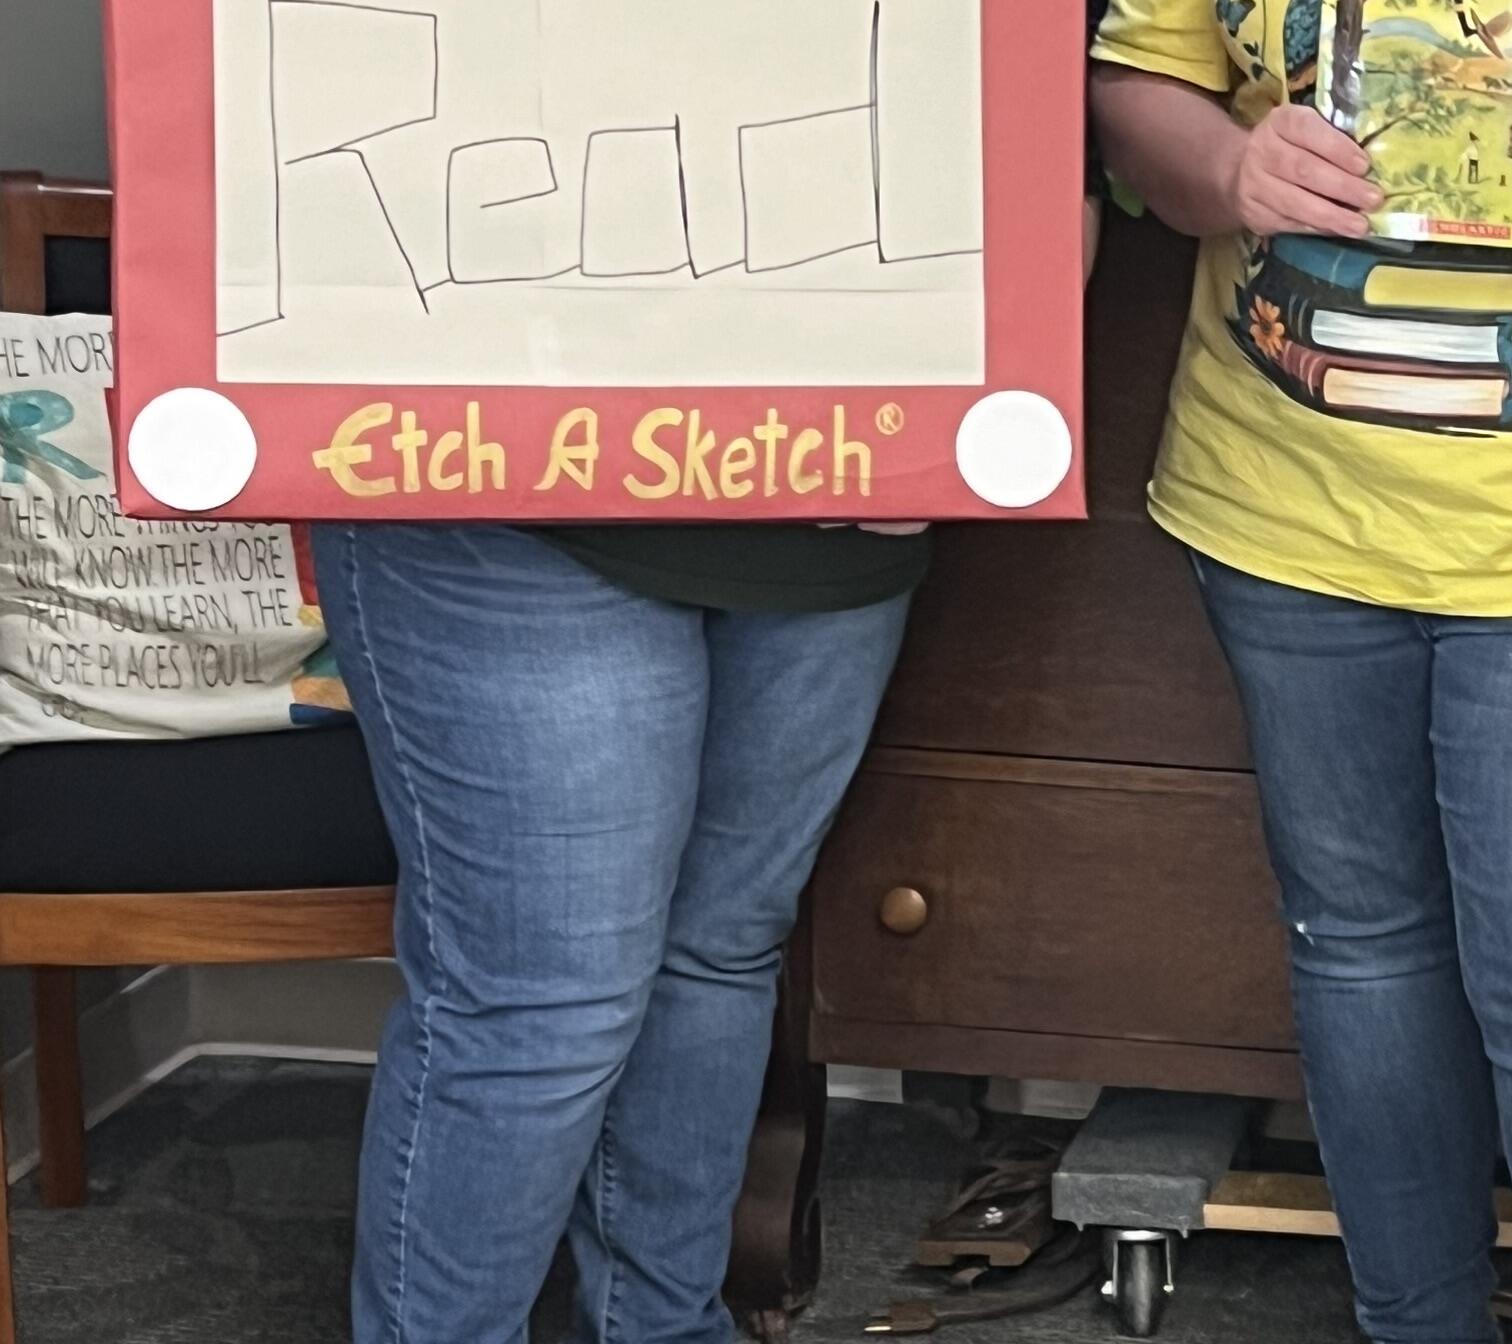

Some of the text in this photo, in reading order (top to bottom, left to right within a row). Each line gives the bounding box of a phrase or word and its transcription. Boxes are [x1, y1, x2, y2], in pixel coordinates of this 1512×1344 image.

[0, 332, 114, 378] HE MOR
[313, 401, 507, 498] Etch
[532, 406, 600, 492] A
[1, 493, 126, 540] THE MORE
[156, 542, 206, 586] THE
[208, 535, 286, 582] MORE
[241, 588, 293, 628] THE
[27, 642, 96, 686] MORE
[99, 644, 182, 690] PLACES
